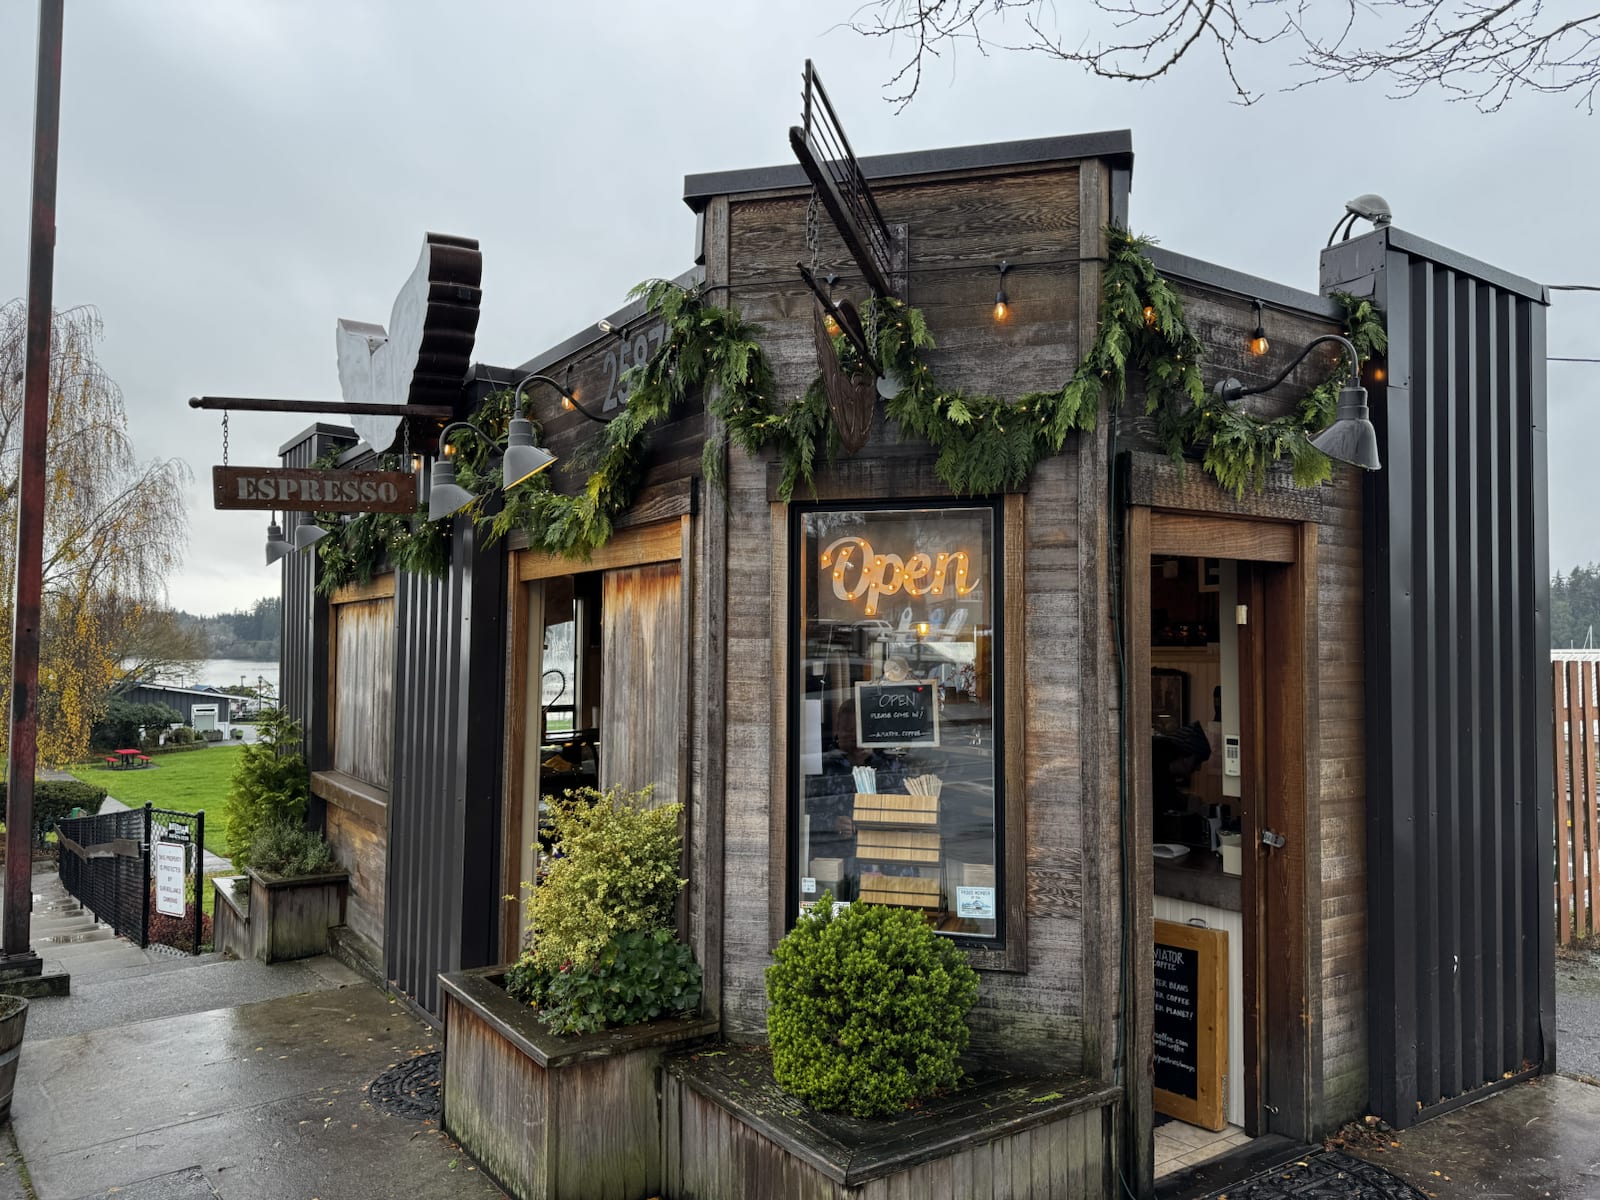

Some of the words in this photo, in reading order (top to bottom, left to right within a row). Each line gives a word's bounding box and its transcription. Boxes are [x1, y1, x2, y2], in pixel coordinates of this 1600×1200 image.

[237, 477, 398, 503] ESPRESSO
[821, 536, 980, 616] Open
[879, 692, 916, 707] OPEN
[1154, 948, 1184, 965] VIATOR
